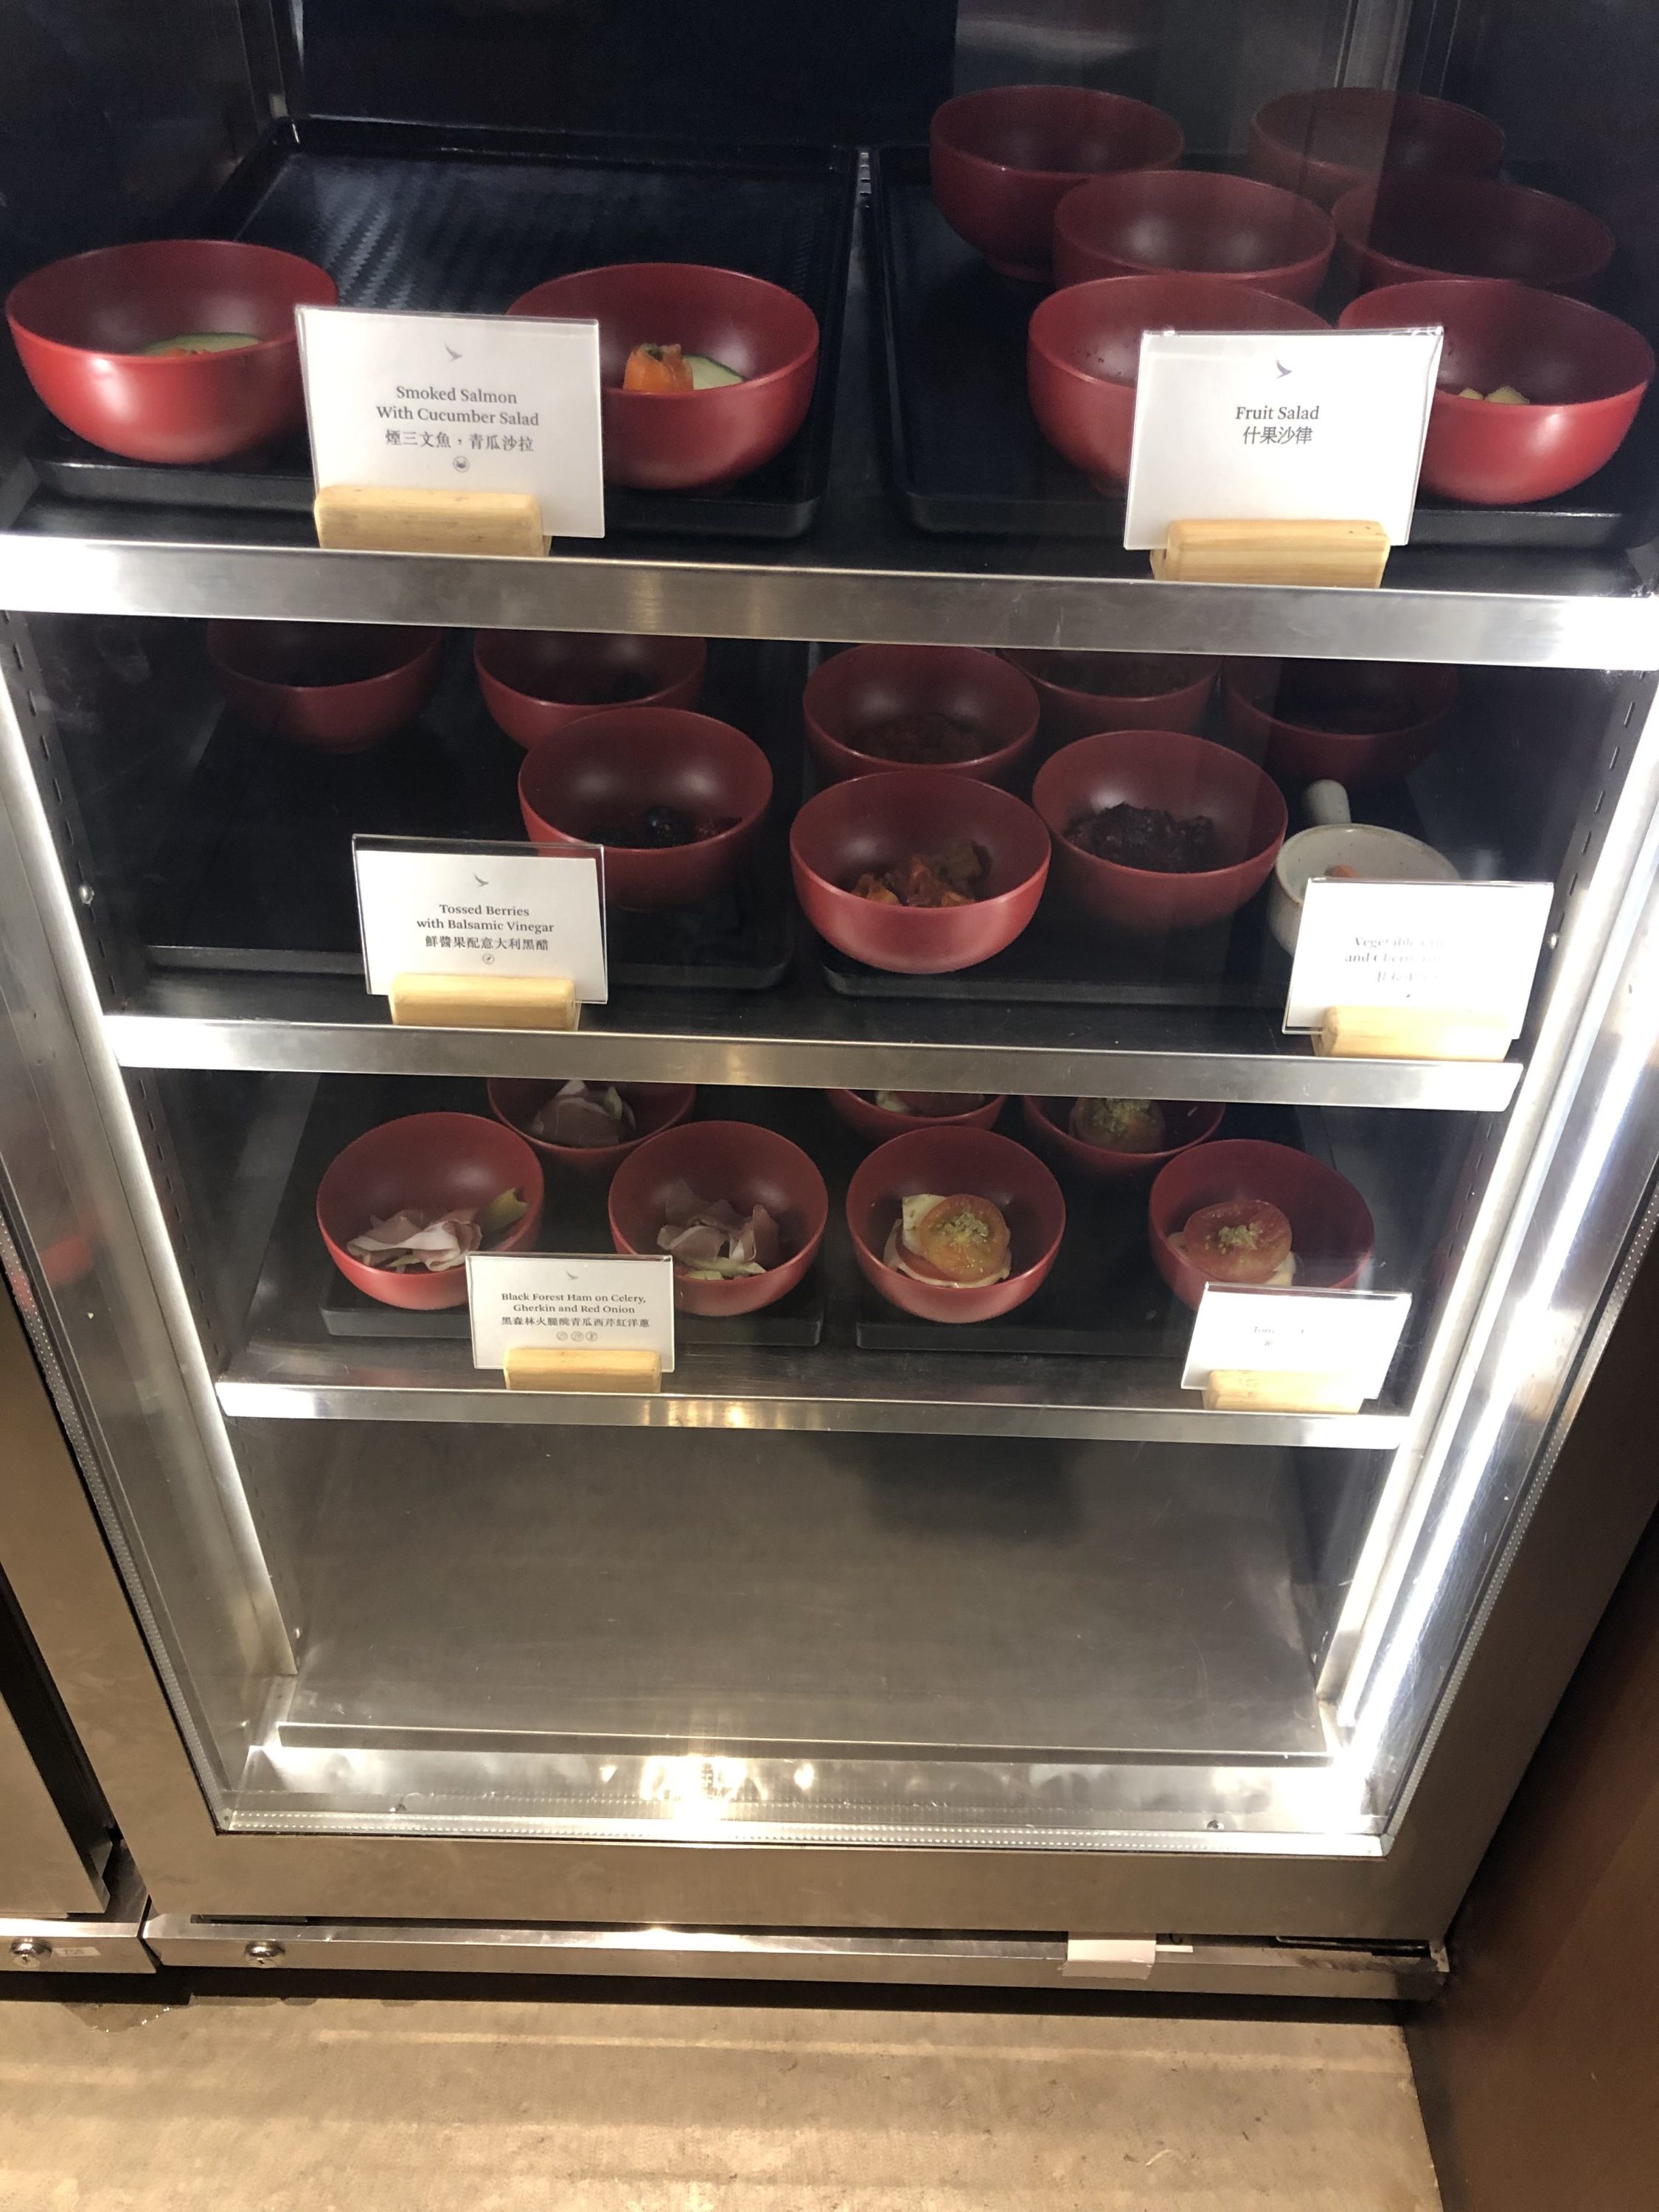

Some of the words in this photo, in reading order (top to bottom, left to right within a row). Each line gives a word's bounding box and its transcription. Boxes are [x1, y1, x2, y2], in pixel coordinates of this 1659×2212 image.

[396, 386, 456, 401] Smoked
[460, 389, 518, 404] Salmon
[377, 406, 414, 420] With
[417, 408, 496, 424] Cucumber
[499, 411, 540, 426] Salad
[1236, 405, 1273, 420] Fruit
[1277, 405, 1320, 420] Salad
[1243, 425, 1313, 445] 什果沙律
[439, 904, 482, 915] Tossed
[486, 905, 530, 917] Berries
[417, 918, 444, 929] with
[448, 919, 504, 931] Balsamic
[507, 922, 554, 934] Vinegar
[501, 1293, 529, 1301] Black
[532, 1293, 564, 1301] Forest
[567, 1294, 592, 1302] Ham
[611, 1294, 646, 1304] Celery,
